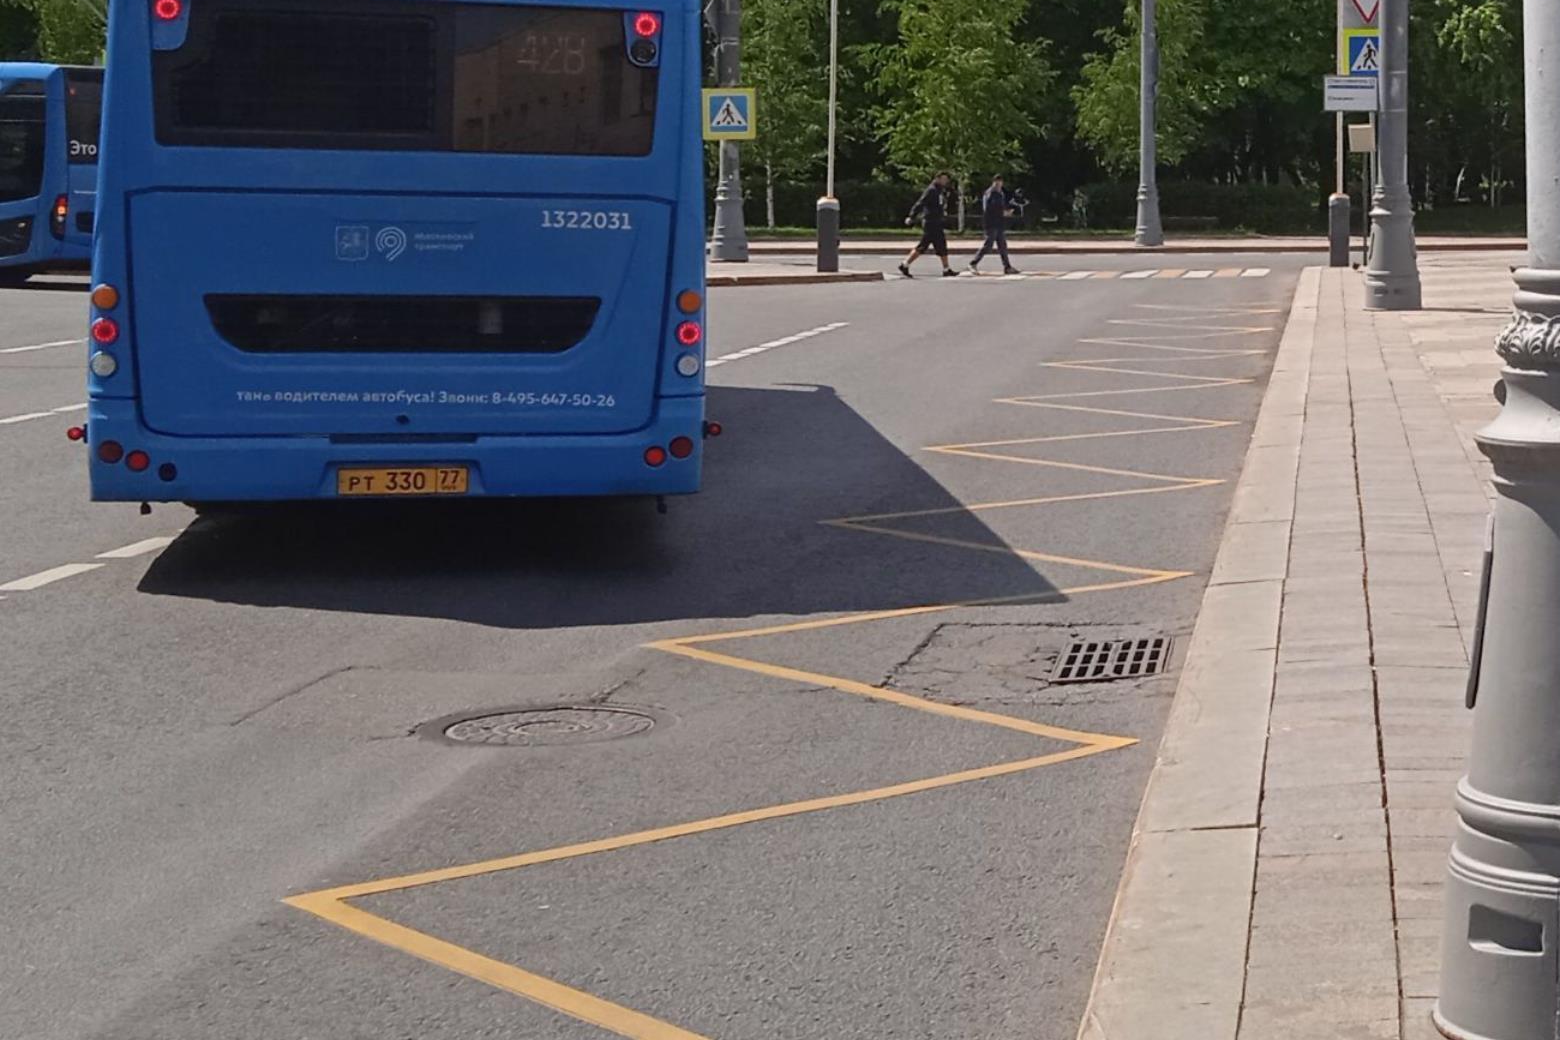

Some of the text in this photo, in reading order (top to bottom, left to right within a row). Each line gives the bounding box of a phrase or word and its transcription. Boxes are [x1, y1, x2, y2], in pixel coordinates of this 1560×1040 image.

[69, 140, 98, 156] Это
[540, 210, 632, 230] 1322031
[275, 391, 359, 403] водителем
[362, 390, 435, 405] автобуса!
[491, 391, 616, 408] 8-495-647-50-26
[385, 471, 426, 491] 330
[439, 470, 460, 485] 77
